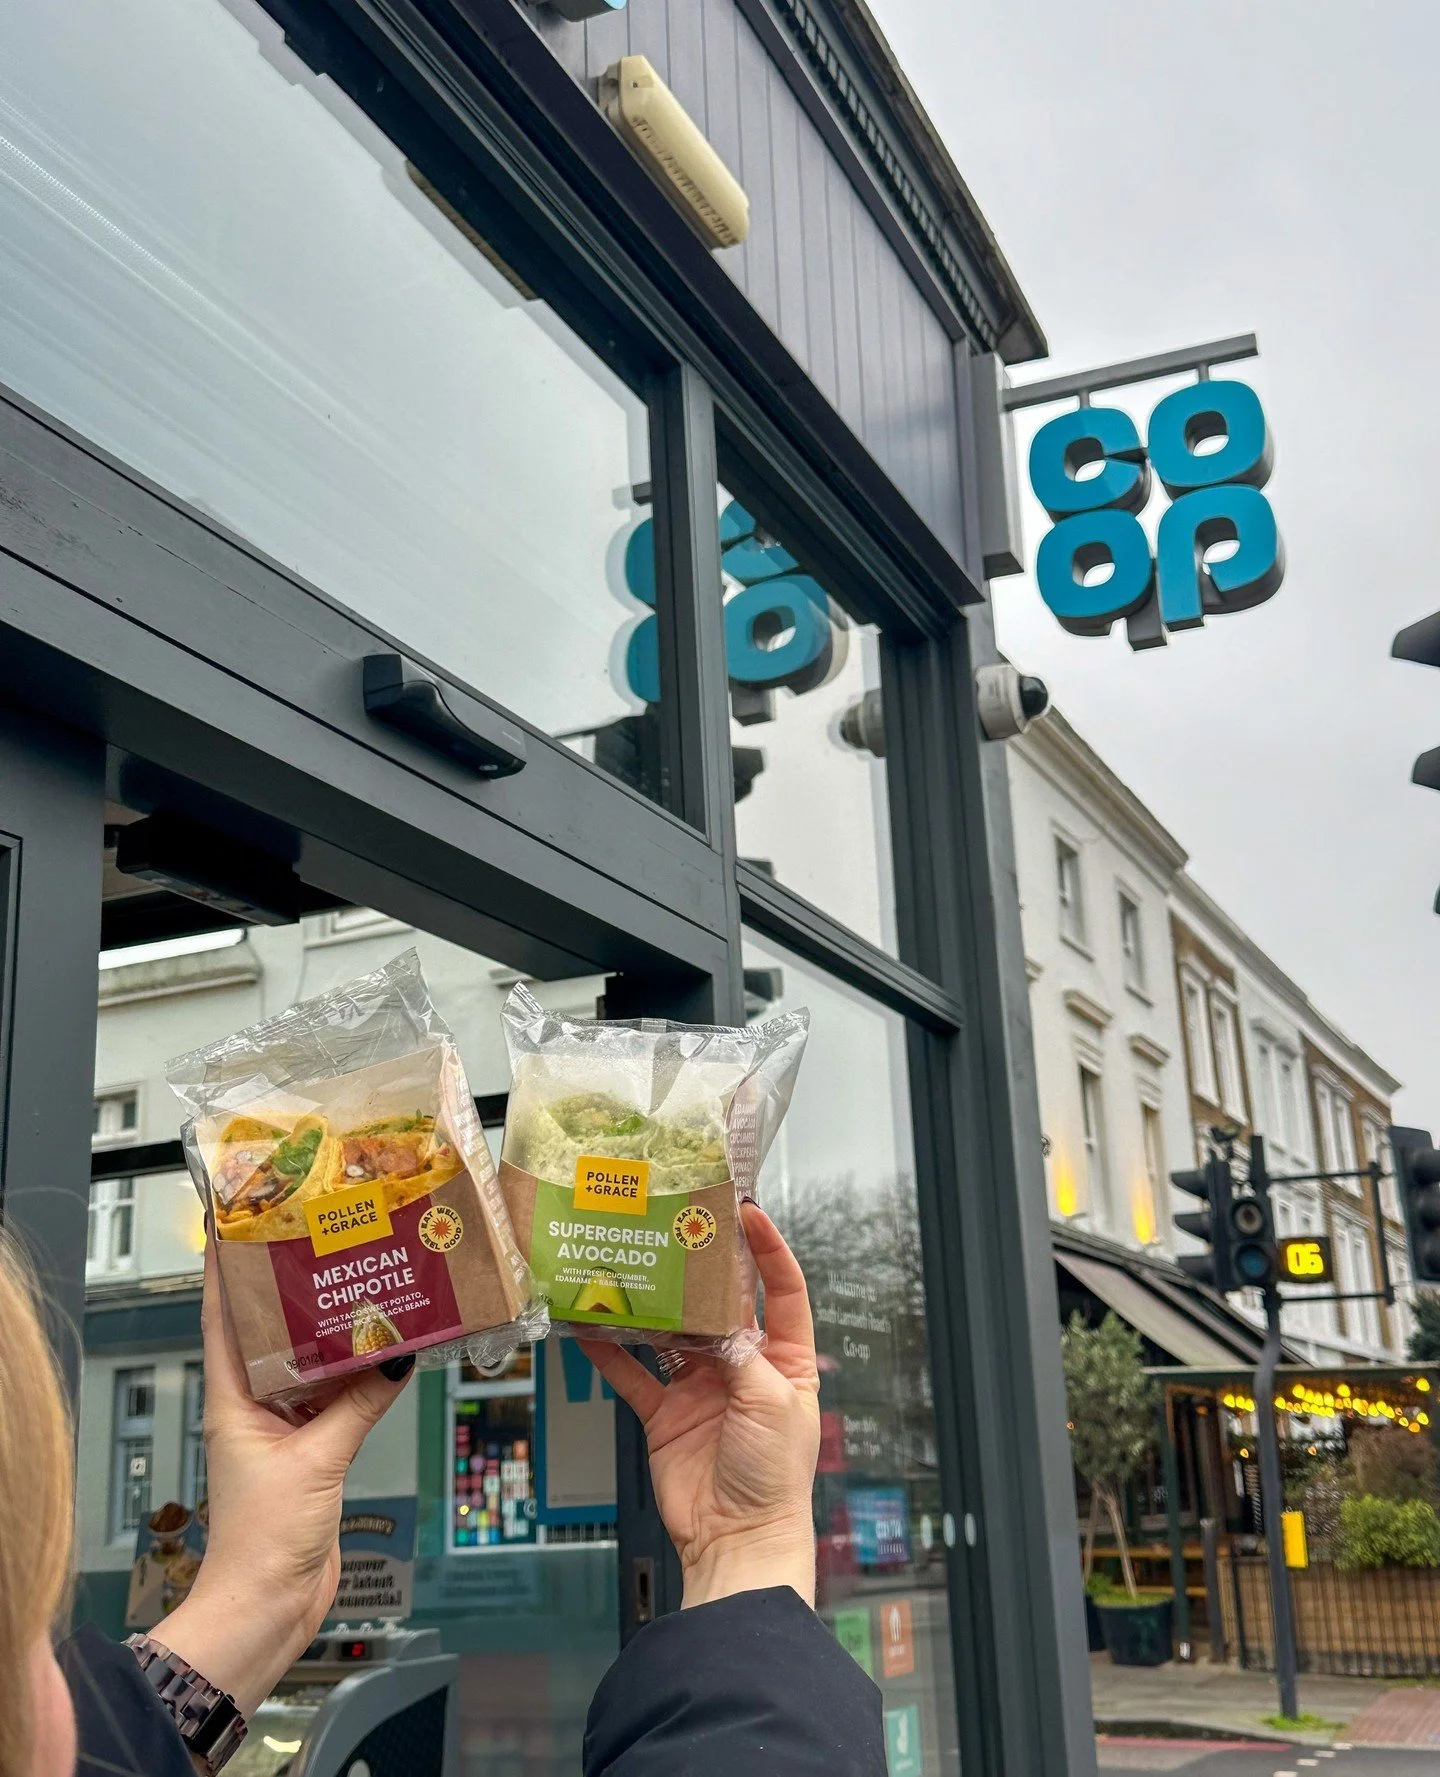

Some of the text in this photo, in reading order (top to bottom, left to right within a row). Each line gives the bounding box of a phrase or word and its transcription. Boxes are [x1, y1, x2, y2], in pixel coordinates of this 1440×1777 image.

[587, 1172, 639, 1186] POLLEN
[586, 1185, 638, 1198] +GRACE
[318, 1199, 375, 1225] POLLEN
[322, 1212, 378, 1236] +GRACE
[421, 1208, 458, 1229] EAT WELL
[677, 1208, 714, 1228] EAT WELL
[421, 1227, 462, 1250] FEEL GOOD
[548, 1221, 669, 1248] SUPERGREEN
[675, 1227, 714, 1249] FEEL GOOD
[557, 1242, 657, 1267] AVOCADO
[312, 1246, 409, 1289] MEXICAN
[562, 1267, 582, 1276] WITH
[317, 1267, 415, 1310] CHIPOTLE
[315, 1322, 352, 1338] CHIPOTLE
[405, 1298, 431, 1311] BEANS
[318, 1316, 339, 1328] WITH
[340, 1309, 362, 1321] TACO
[390, 1292, 424, 1307] POTATO,
